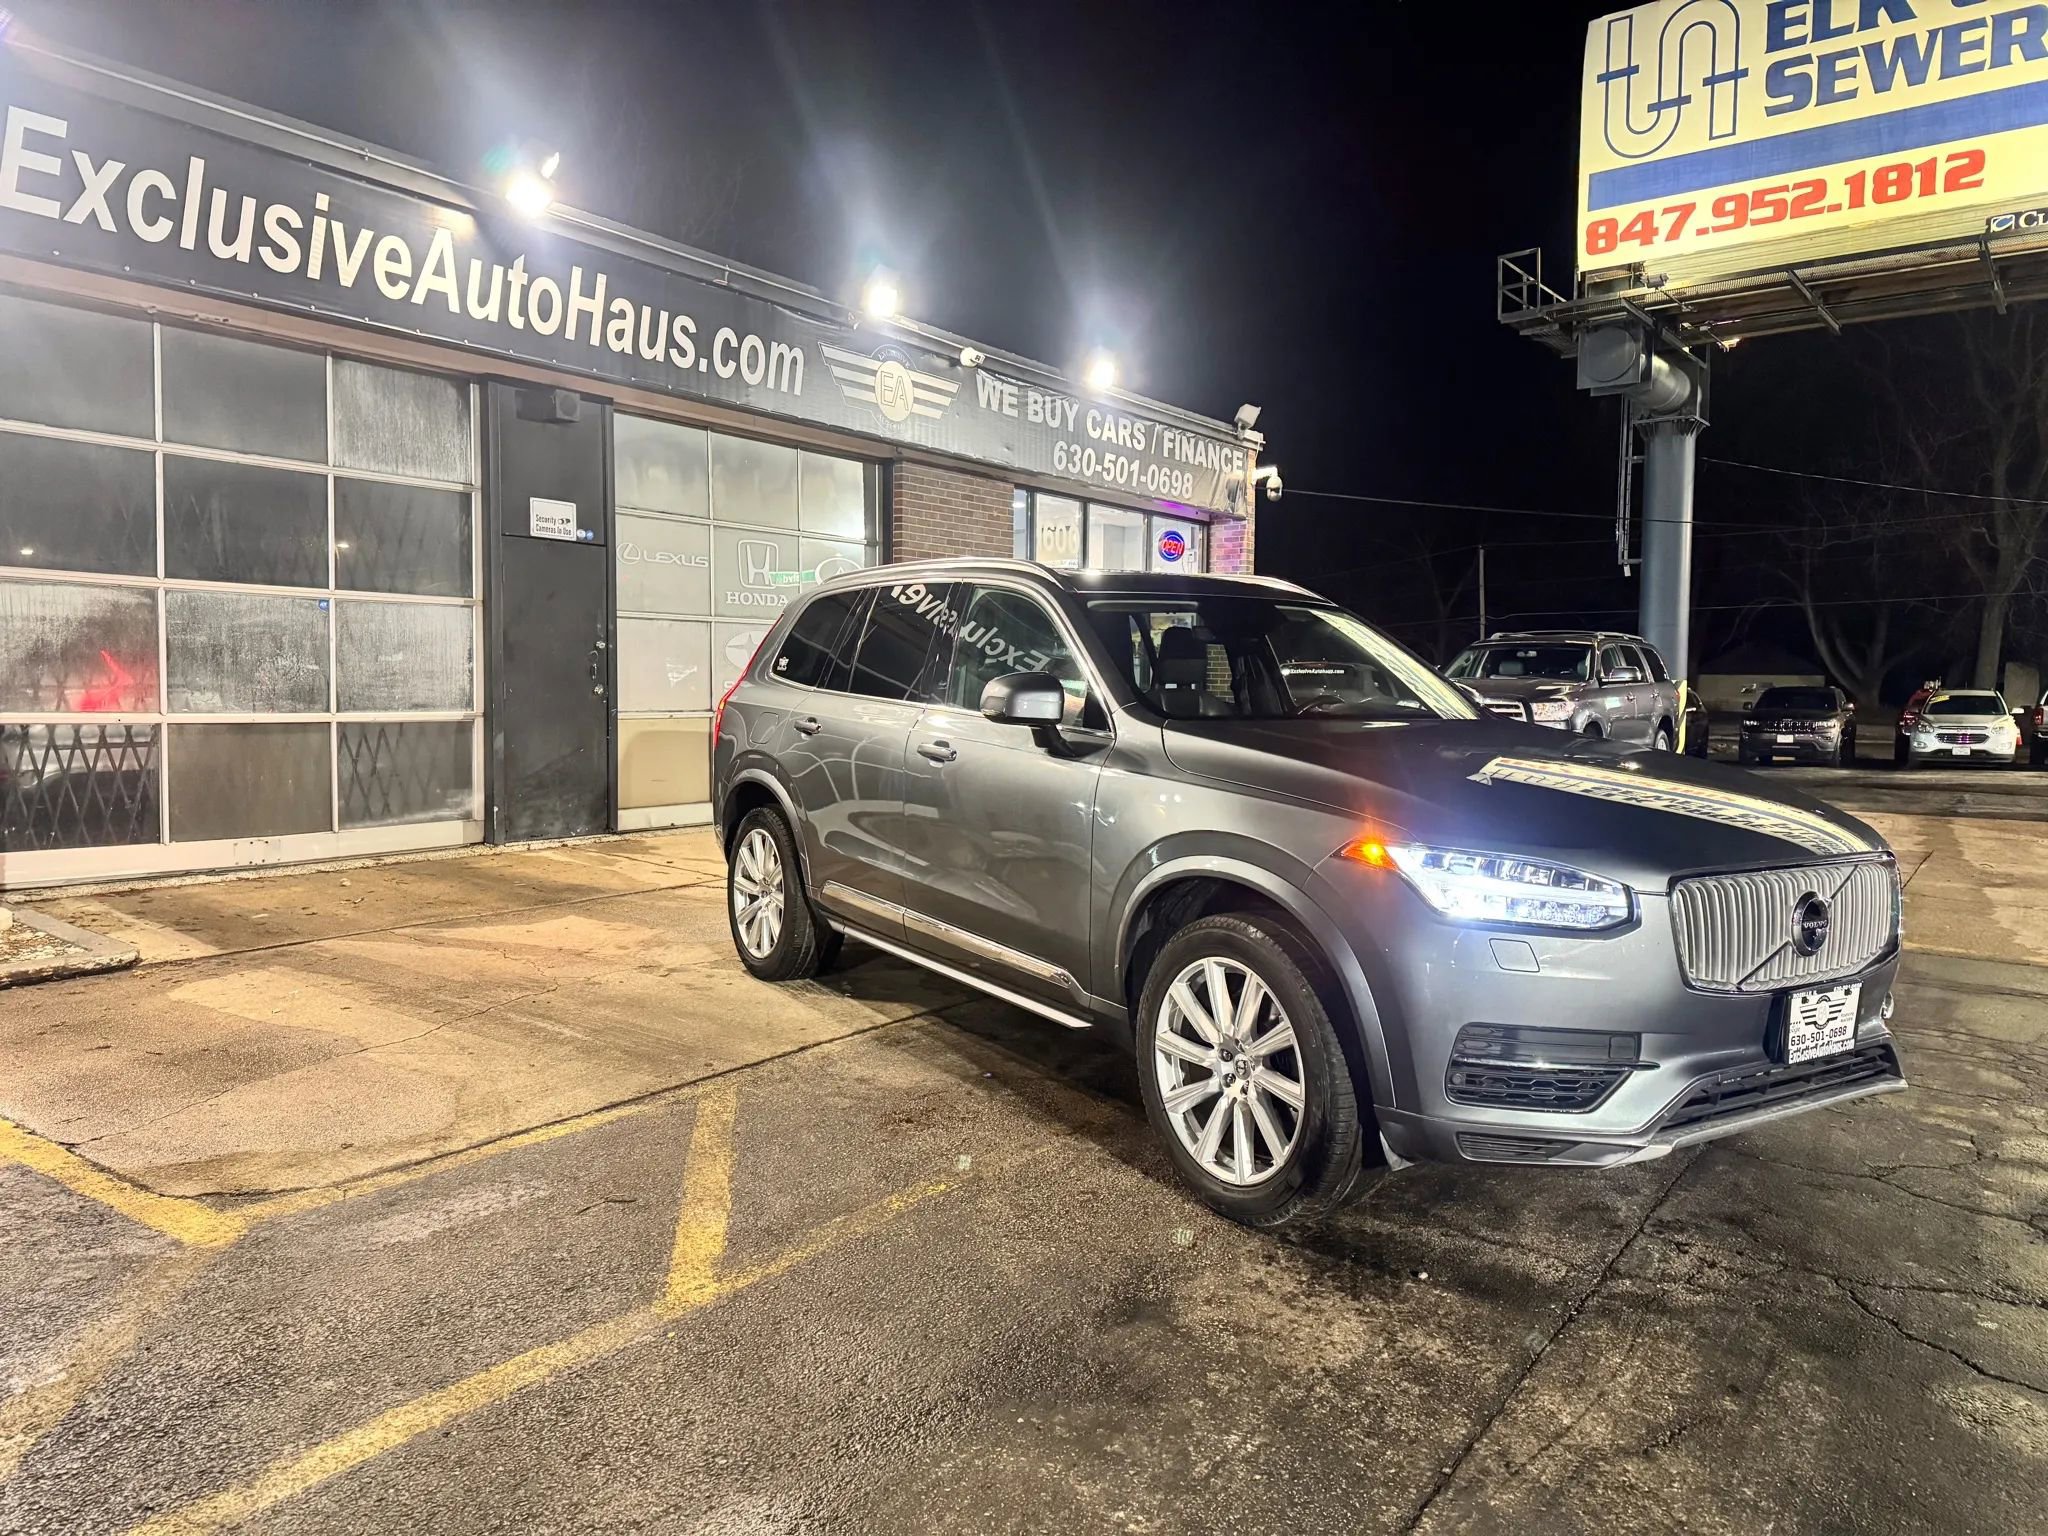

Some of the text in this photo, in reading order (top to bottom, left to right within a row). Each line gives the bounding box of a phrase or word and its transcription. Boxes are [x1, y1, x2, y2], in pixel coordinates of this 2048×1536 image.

[1585, 149, 1986, 256] 847.952.1812
[0, 105, 805, 396] ExclusiveAutoHaus.com
[976, 373, 1018, 418] WE
[1027, 390, 1079, 432] BUY
[1086, 408, 1146, 451] CARS
[1163, 430, 1243, 475] FINANCE
[1053, 440, 1193, 499] 630-501-0698
[535, 514, 556, 526] Security
[535, 523, 556, 534] Cameras
[563, 527, 572, 536] Use
[1161, 539, 1184, 555] OPEN
[643, 549, 709, 568] LEXUS
[726, 591, 790, 607] HONDA
[1790, 1026, 1848, 1046] 630-501-0698
